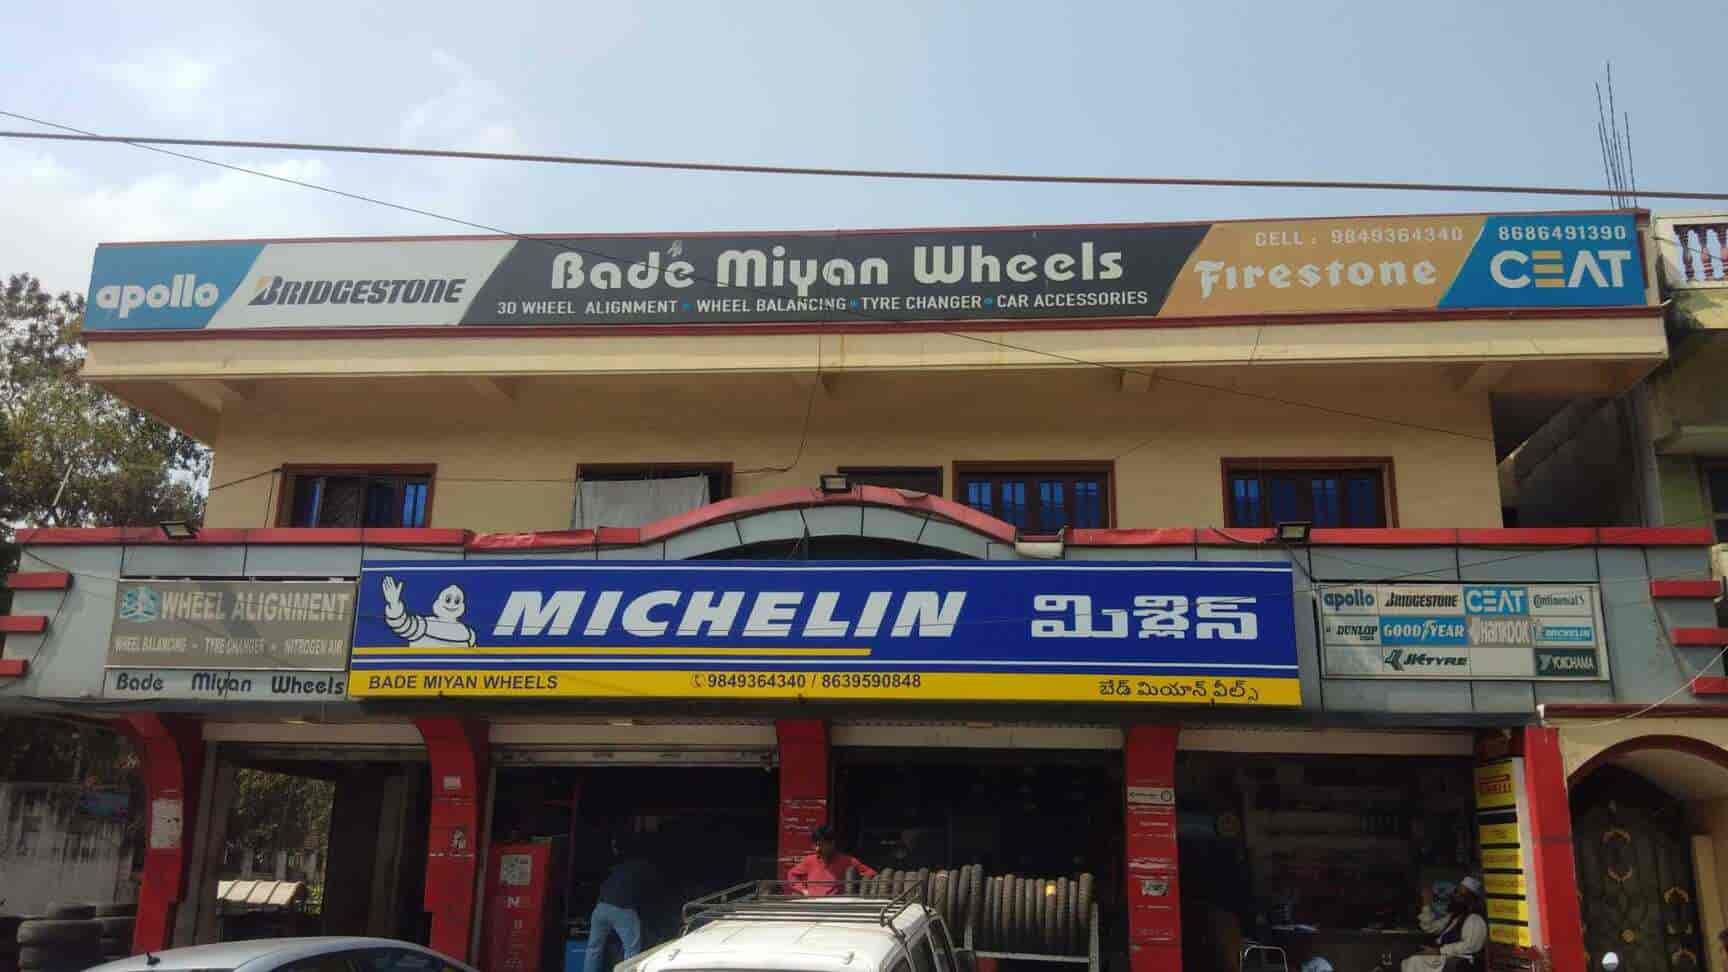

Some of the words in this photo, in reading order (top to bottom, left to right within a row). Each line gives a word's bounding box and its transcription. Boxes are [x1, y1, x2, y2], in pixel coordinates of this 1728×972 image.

[1255, 231, 1305, 247] CELL
[1331, 226, 1464, 244] 9849364340
[1498, 225, 1627, 242] 8686491390
[716, 245, 889, 297] Miyan
[913, 241, 1124, 285] Wheels
[1193, 256, 1438, 298] Firestone
[1489, 249, 1632, 288] CEAT
[95, 273, 220, 319] apollo
[248, 275, 466, 306] BRIDGESTONE
[521, 300, 577, 315] WHEEL
[584, 299, 678, 314] ALIGNMENT
[696, 298, 750, 313] WHEEL
[756, 297, 847, 313] BALANCING
[860, 296, 901, 311] TYRE
[905, 295, 982, 310] CHANGER
[996, 292, 1028, 308] CAR
[1033, 290, 1149, 308] ACCESSORIES
[160, 591, 226, 621] WHEEL
[231, 591, 351, 622] ALIGNMENT
[1324, 589, 1375, 611] apollo
[1465, 590, 1523, 613] CEAT
[492, 590, 967, 637] MICHELIN
[1335, 624, 1378, 636] DUNLOP
[1384, 619, 1465, 641] GOODYEAR
[115, 672, 164, 692] Bade
[271, 674, 344, 695] Wheels
[368, 674, 416, 690] BADE
[422, 674, 478, 689] MIYAN
[483, 675, 559, 690] WHEELS
[707, 673, 807, 690] 9849364340
[820, 674, 922, 690] 8639590848
